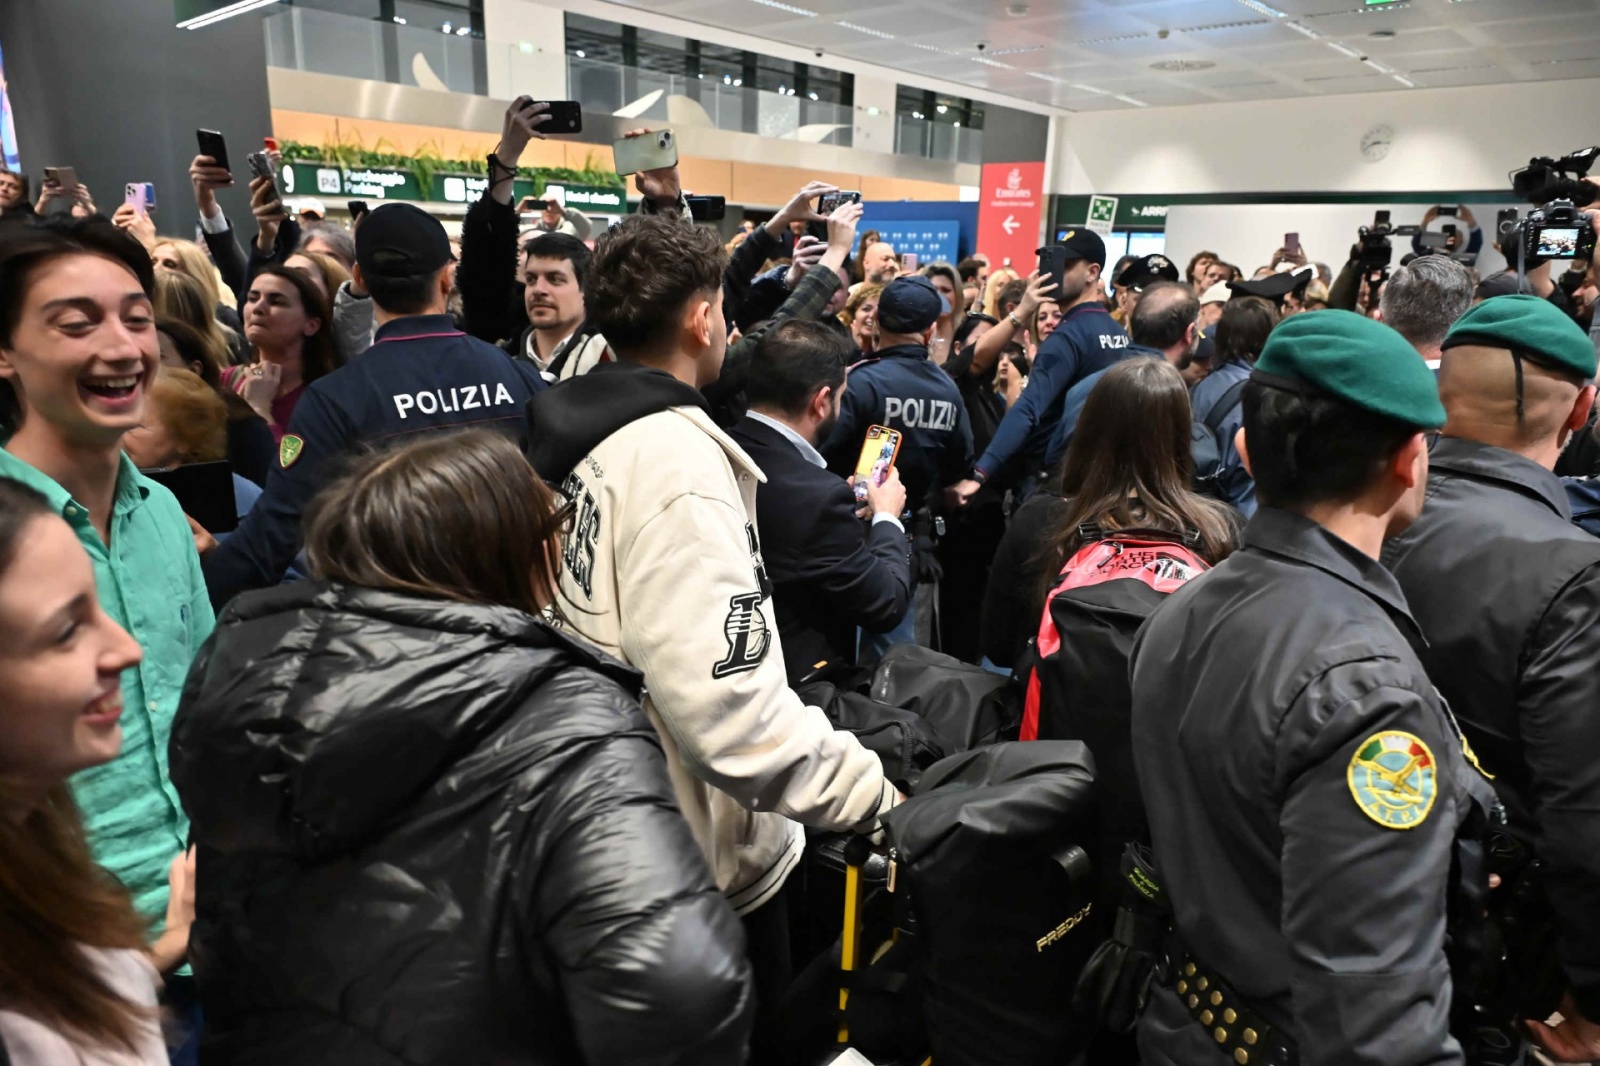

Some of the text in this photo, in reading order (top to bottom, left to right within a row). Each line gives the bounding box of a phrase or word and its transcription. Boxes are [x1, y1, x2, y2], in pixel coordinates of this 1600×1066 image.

[321, 177, 338, 189] P4
[344, 181, 385, 199] Parking
[1140, 205, 1169, 217] ARRI
[393, 382, 515, 419] POLIZIA
[1036, 902, 1092, 952] FREDDY
